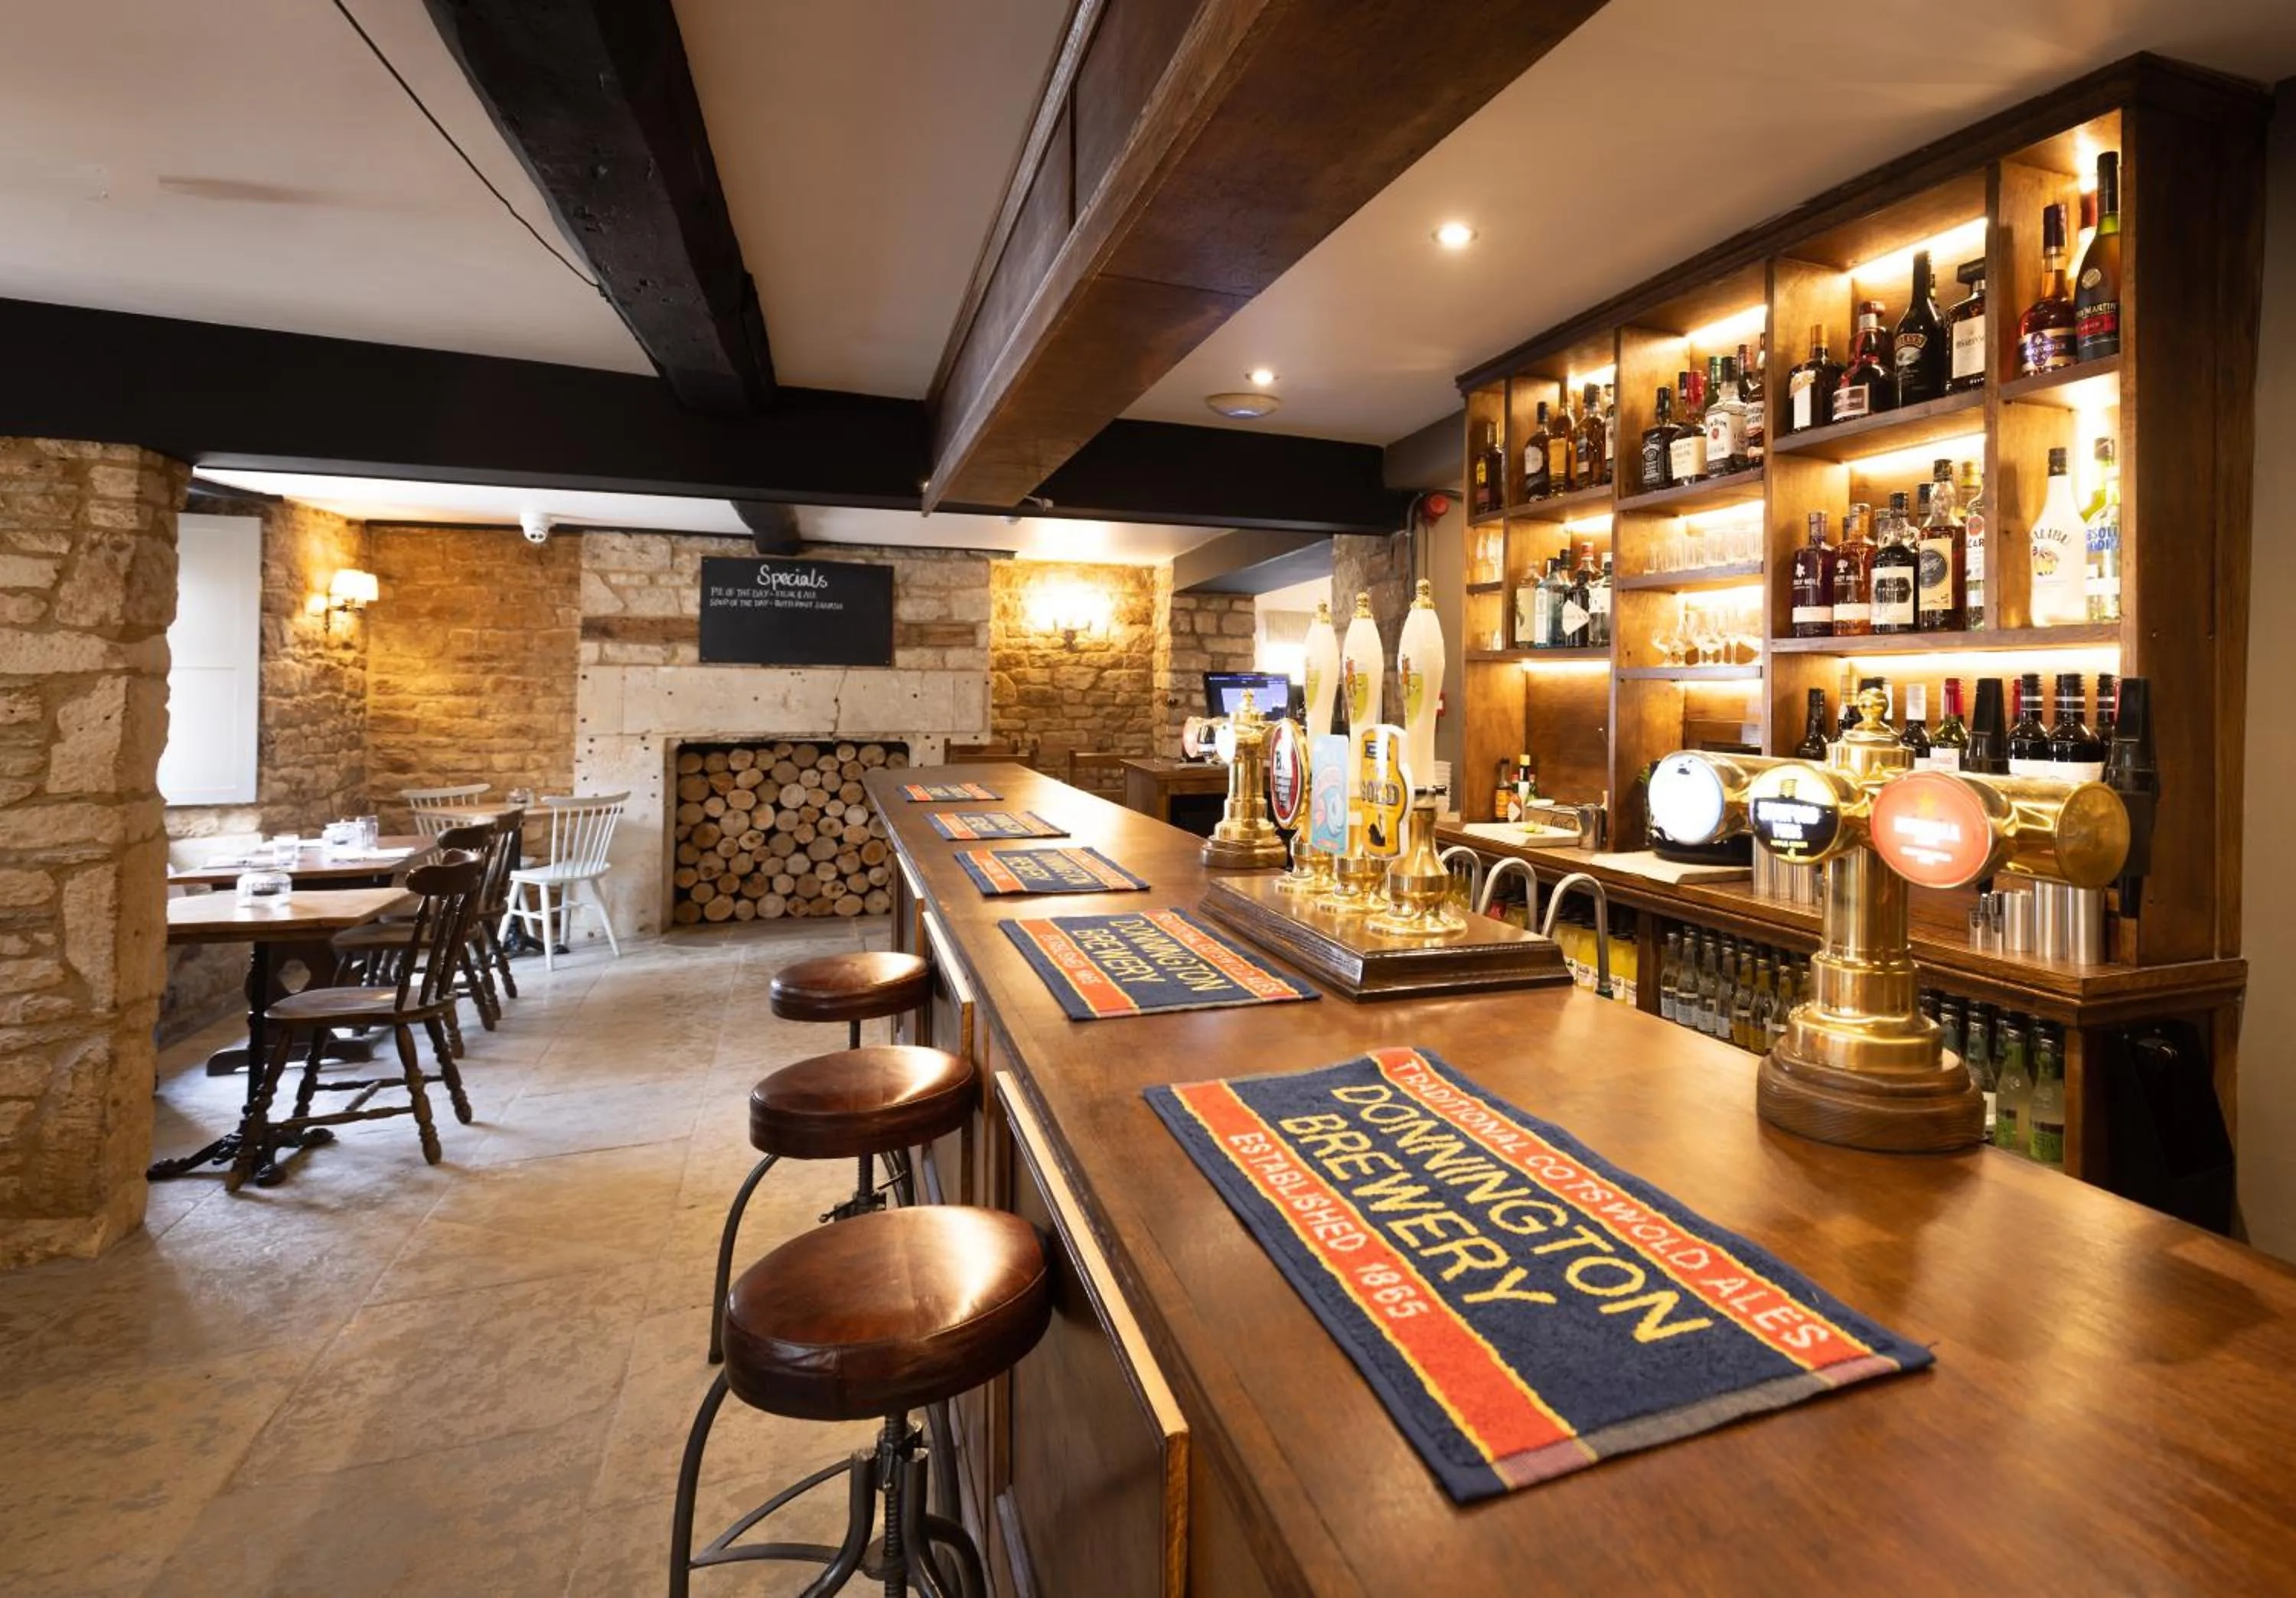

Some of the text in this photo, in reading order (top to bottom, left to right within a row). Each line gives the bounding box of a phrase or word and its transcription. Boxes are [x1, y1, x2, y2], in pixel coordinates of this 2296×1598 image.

[752, 589, 768, 598] DAY
[757, 563, 829, 591] Specials
[1071, 928, 1166, 982] BREWERY
[1109, 919, 1234, 991] DONNINGTON
[1228, 1131, 1431, 1319] ESTABLISHED 1865
[1279, 1114, 1557, 1304] BREWERY
[1331, 1084, 1713, 1343] DONNINGTON
[1392, 1059, 1831, 1350] TRADITIONAL COTSWOLD ALES
